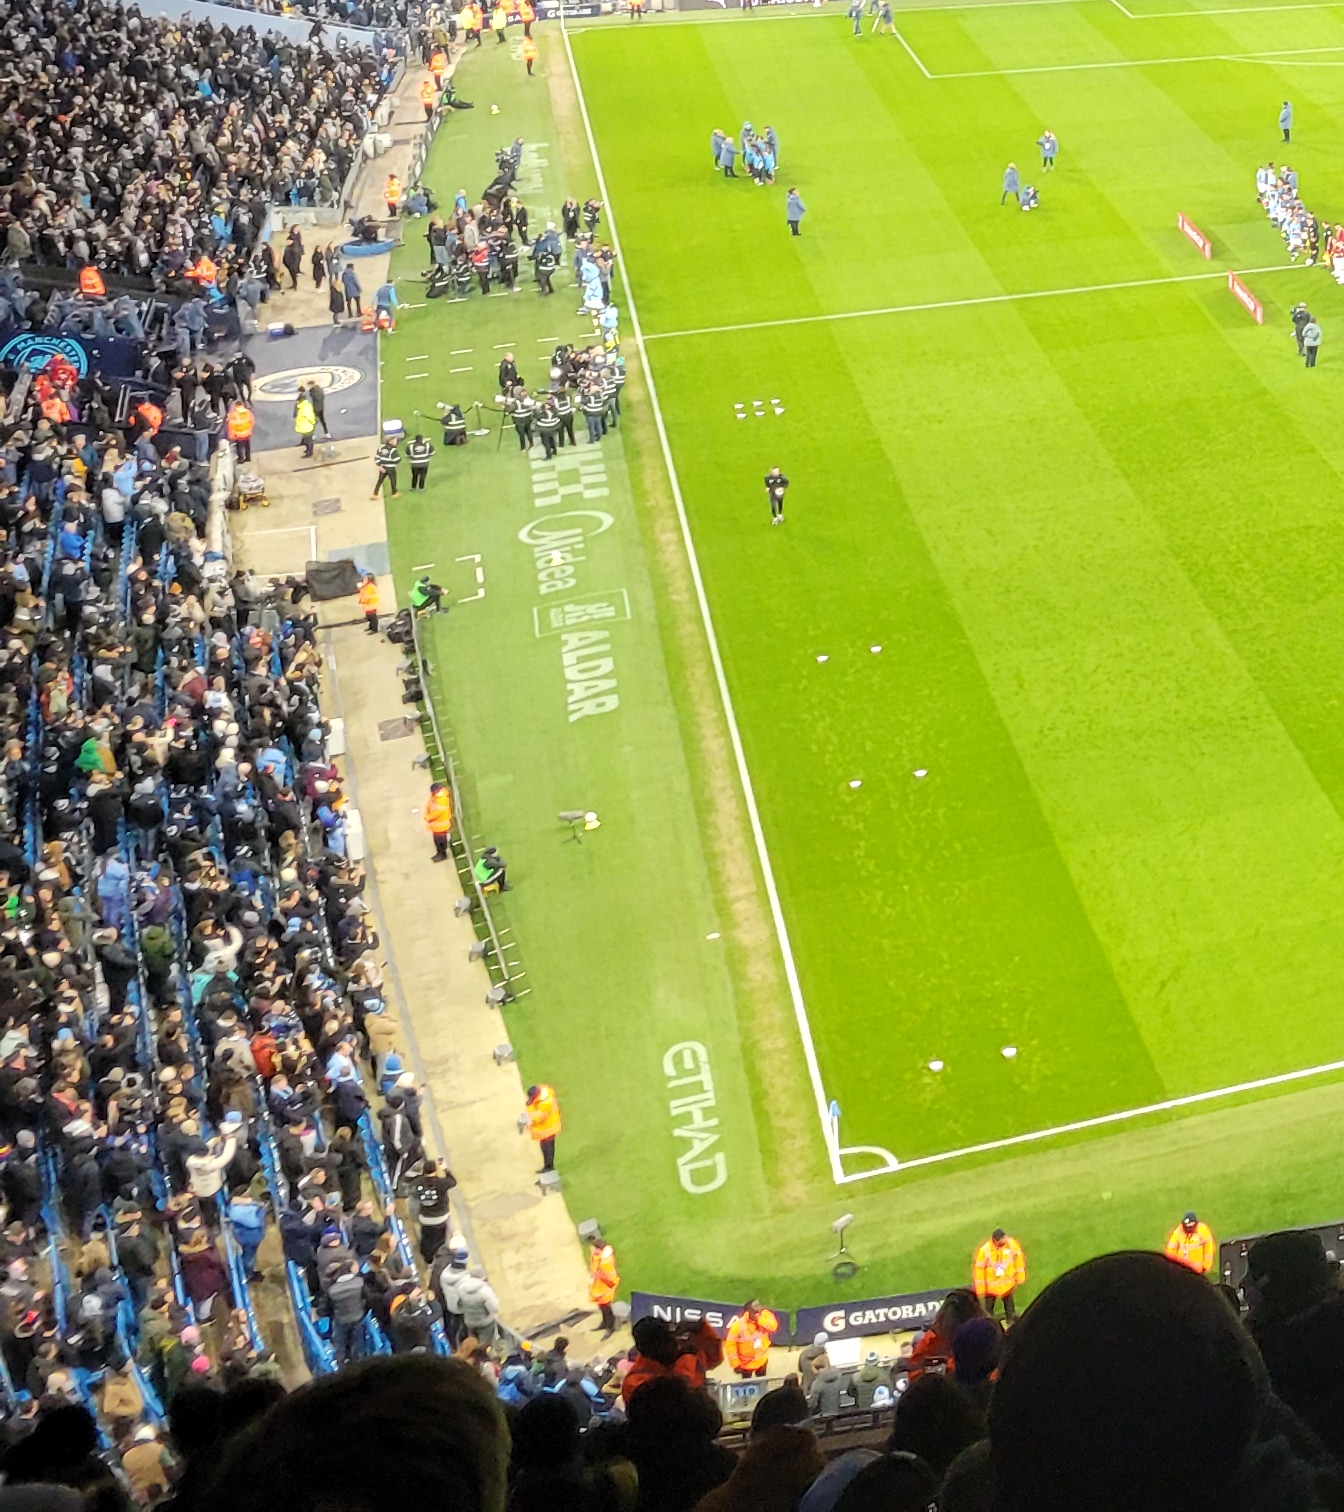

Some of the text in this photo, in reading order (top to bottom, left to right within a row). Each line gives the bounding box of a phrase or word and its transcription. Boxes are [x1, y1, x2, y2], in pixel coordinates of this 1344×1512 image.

[560, 629, 620, 724] ALDAR
[661, 1039, 730, 1196] ETIHAD
[849, 1298, 947, 1328] GATORAD
